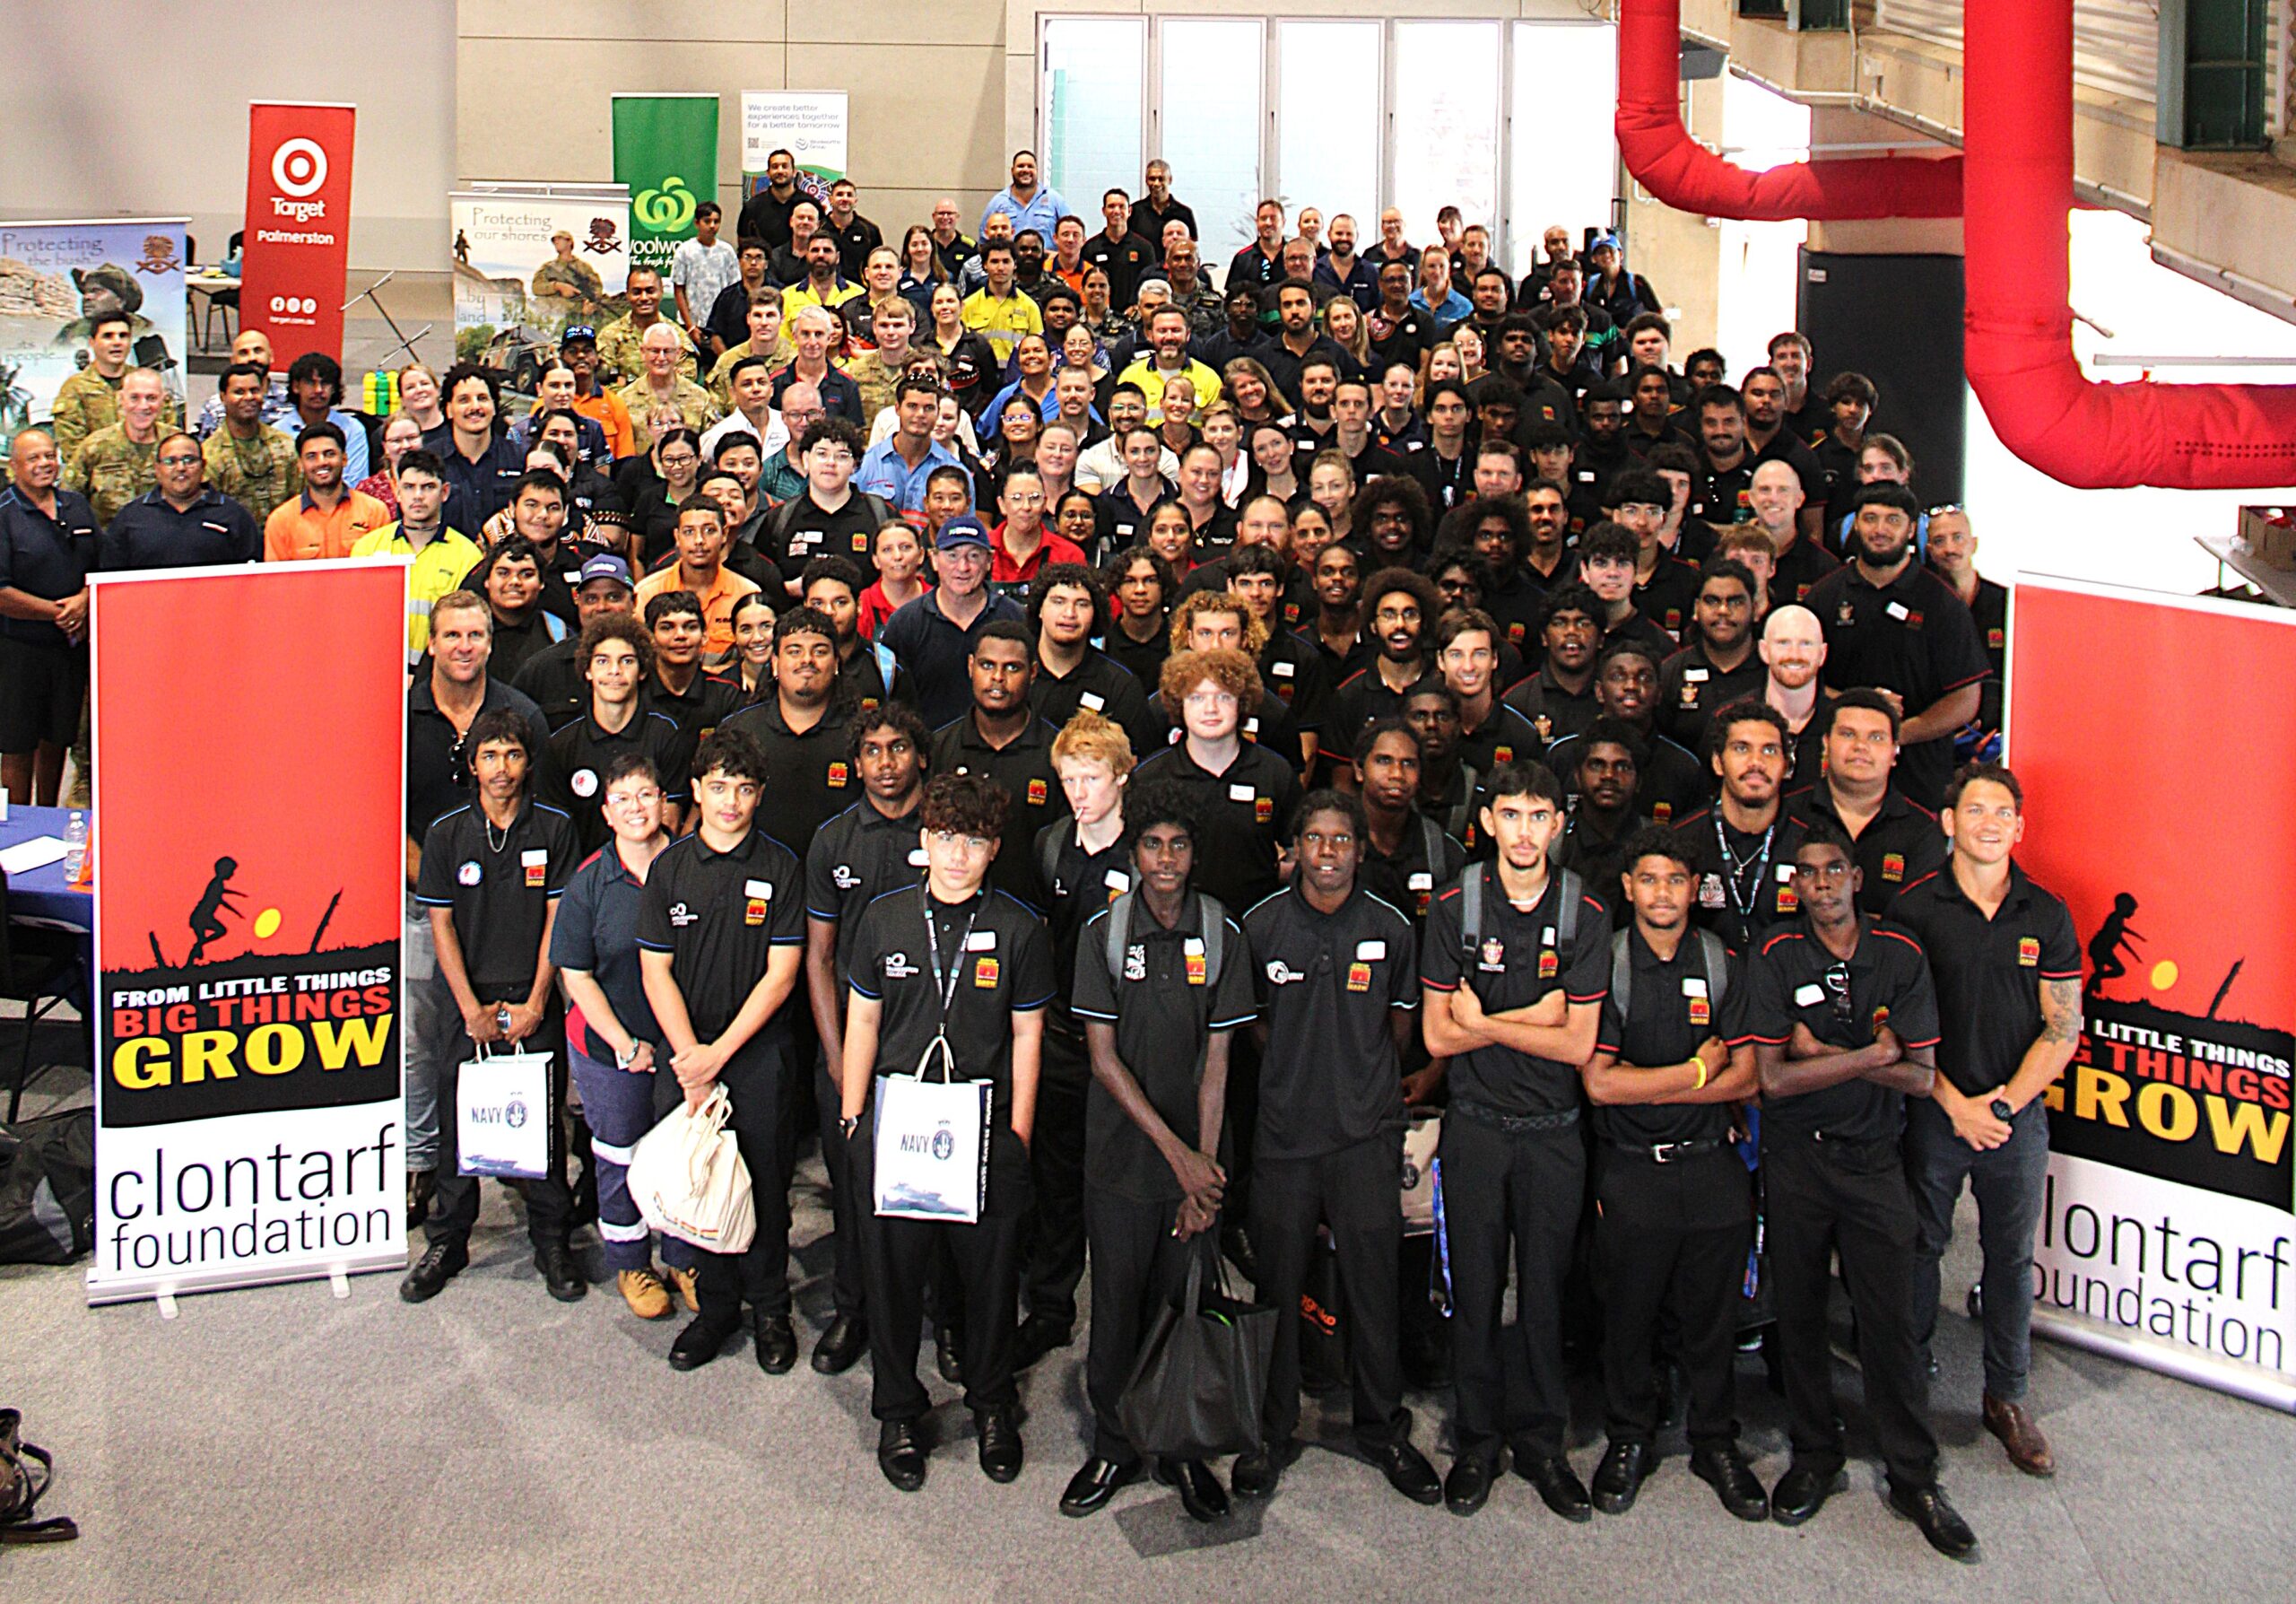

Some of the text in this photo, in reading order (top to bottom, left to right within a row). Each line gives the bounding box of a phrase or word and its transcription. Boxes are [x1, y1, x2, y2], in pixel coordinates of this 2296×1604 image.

[747, 113, 839, 121] experiences together
[270, 196, 326, 222] Target
[473, 207, 552, 231] Protecting
[2, 233, 105, 257] Protecting
[257, 230, 335, 245] Palmerston
[474, 226, 548, 242] our shores
[28, 255, 51, 266] the
[457, 303, 486, 323] land
[112, 966, 392, 1008] FROM LITTLE THINGS
[113, 984, 393, 1039] BIG THINGS
[111, 1013, 394, 1090] GROW
[2093, 1019, 2183, 1054] LITTLE
[2188, 1038, 2291, 1078] THINGS
[2104, 1041, 2292, 1110] THINGS
[471, 1106, 503, 1124] NAVY
[900, 1134, 931, 1153] NAVY
[109, 1122, 396, 1221] clontarf
[110, 1201, 391, 1271] foundation
[2043, 1174, 2291, 1310] lontarf
[2033, 1260, 2283, 1371] oundation
